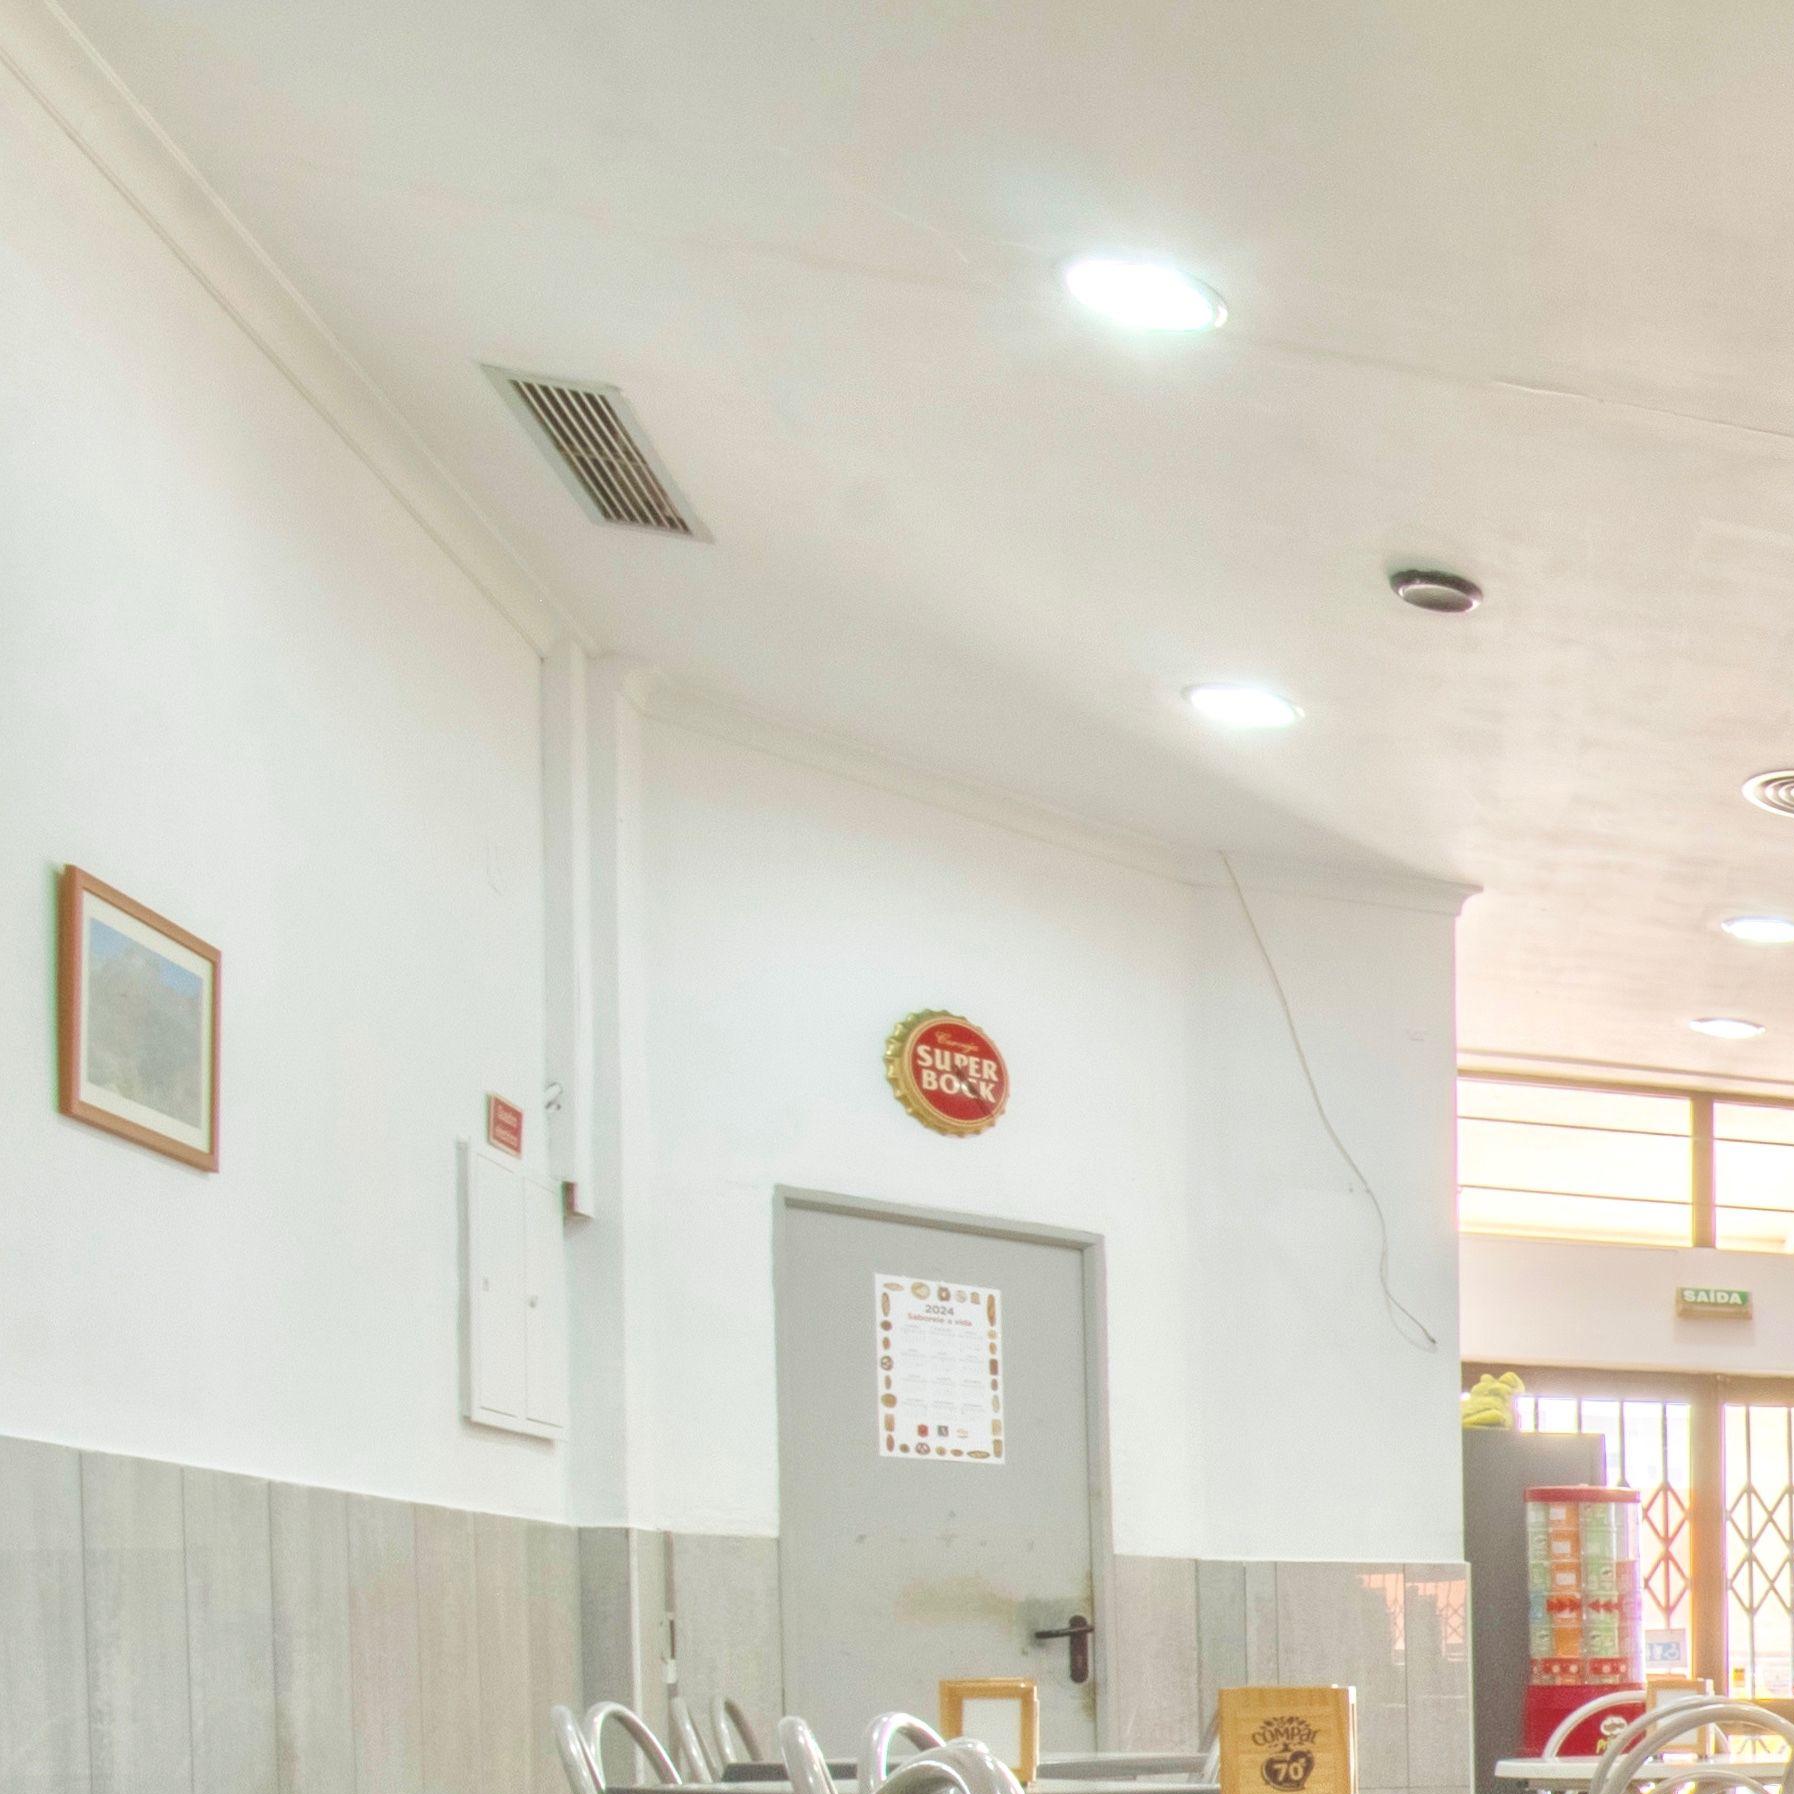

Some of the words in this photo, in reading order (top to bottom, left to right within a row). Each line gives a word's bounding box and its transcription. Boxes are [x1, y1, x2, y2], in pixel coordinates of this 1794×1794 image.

[916, 1043, 998, 1082] SUPER
[921, 1068, 997, 1104] BOCK
[1682, 1289, 1743, 1305] SAÍDA
[924, 1304, 955, 1317] 2024
